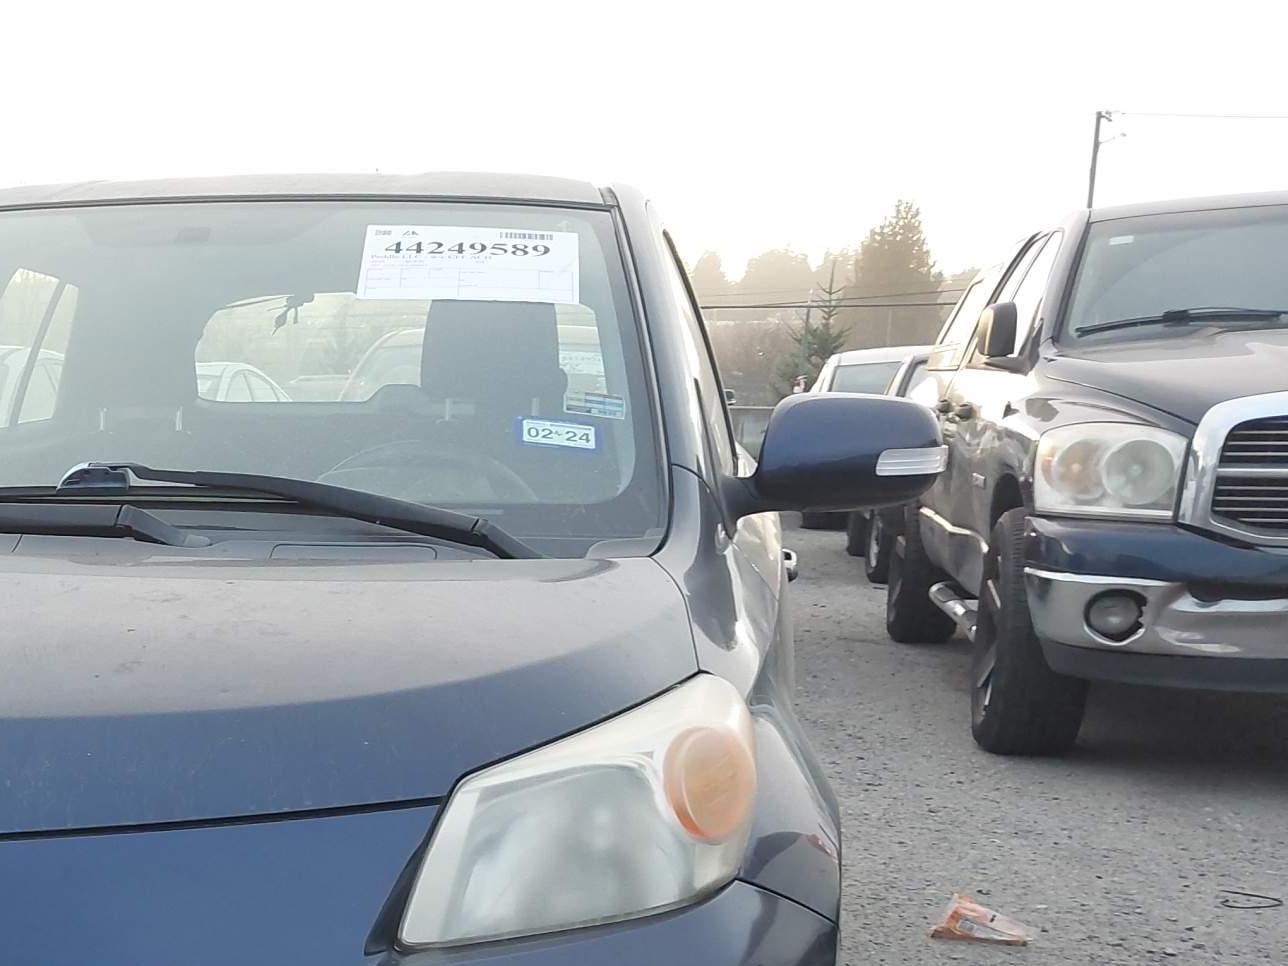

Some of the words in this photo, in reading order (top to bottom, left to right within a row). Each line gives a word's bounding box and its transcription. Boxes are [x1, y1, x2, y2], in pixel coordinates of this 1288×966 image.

[385, 241, 551, 256] 44249589
[527, 426, 554, 439] 02
[565, 430, 591, 444] 24
